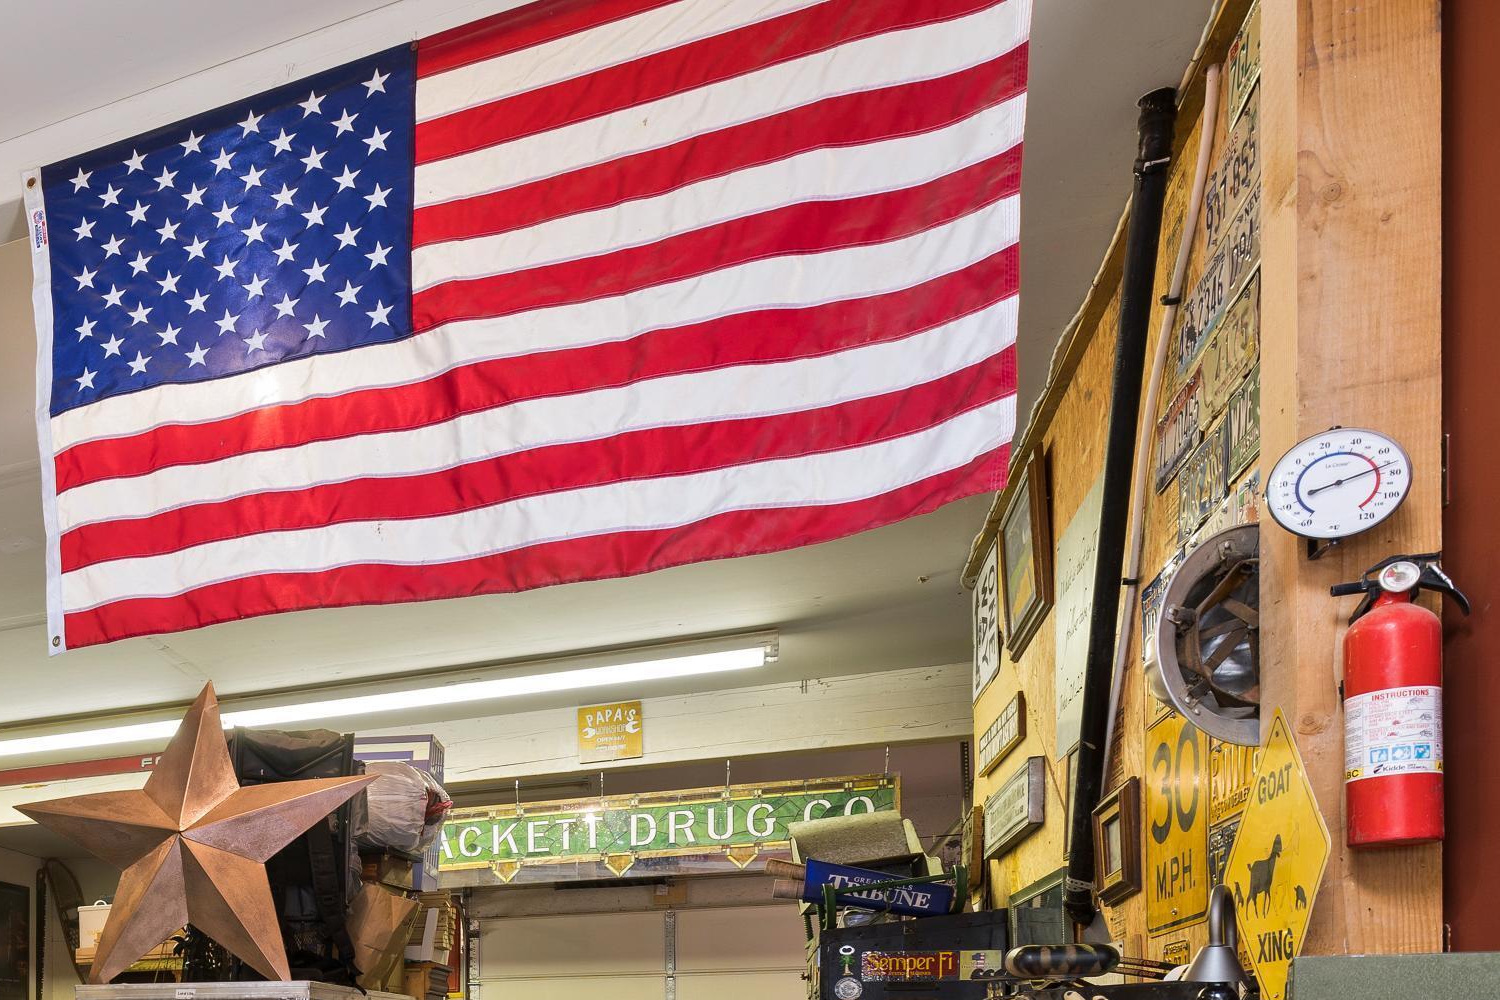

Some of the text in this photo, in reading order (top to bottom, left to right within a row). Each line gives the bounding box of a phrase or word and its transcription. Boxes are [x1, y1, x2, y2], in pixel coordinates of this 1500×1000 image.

[1319, 438, 1362, 450] 20 40
[1378, 447, 1390, 455] 60
[1295, 458, 1302, 466] 0
[1389, 468, 1402, 477] 80
[1383, 491, 1400, 500] 100
[1358, 513, 1376, 521] 120
[1372, 688, 1430, 702] INSTRUCTIONS
[586, 707, 637, 728] PAPA'S
[1382, 763, 1406, 772] Kidde
[1151, 722, 1200, 845] 30
[1258, 762, 1293, 805] GOAT
[630, 802, 777, 848] DRUG
[1156, 847, 1197, 902] M.P.H.
[828, 874, 931, 909] TRIBUNE
[1257, 927, 1293, 964] XING
[867, 951, 953, 980] Semper Fi
